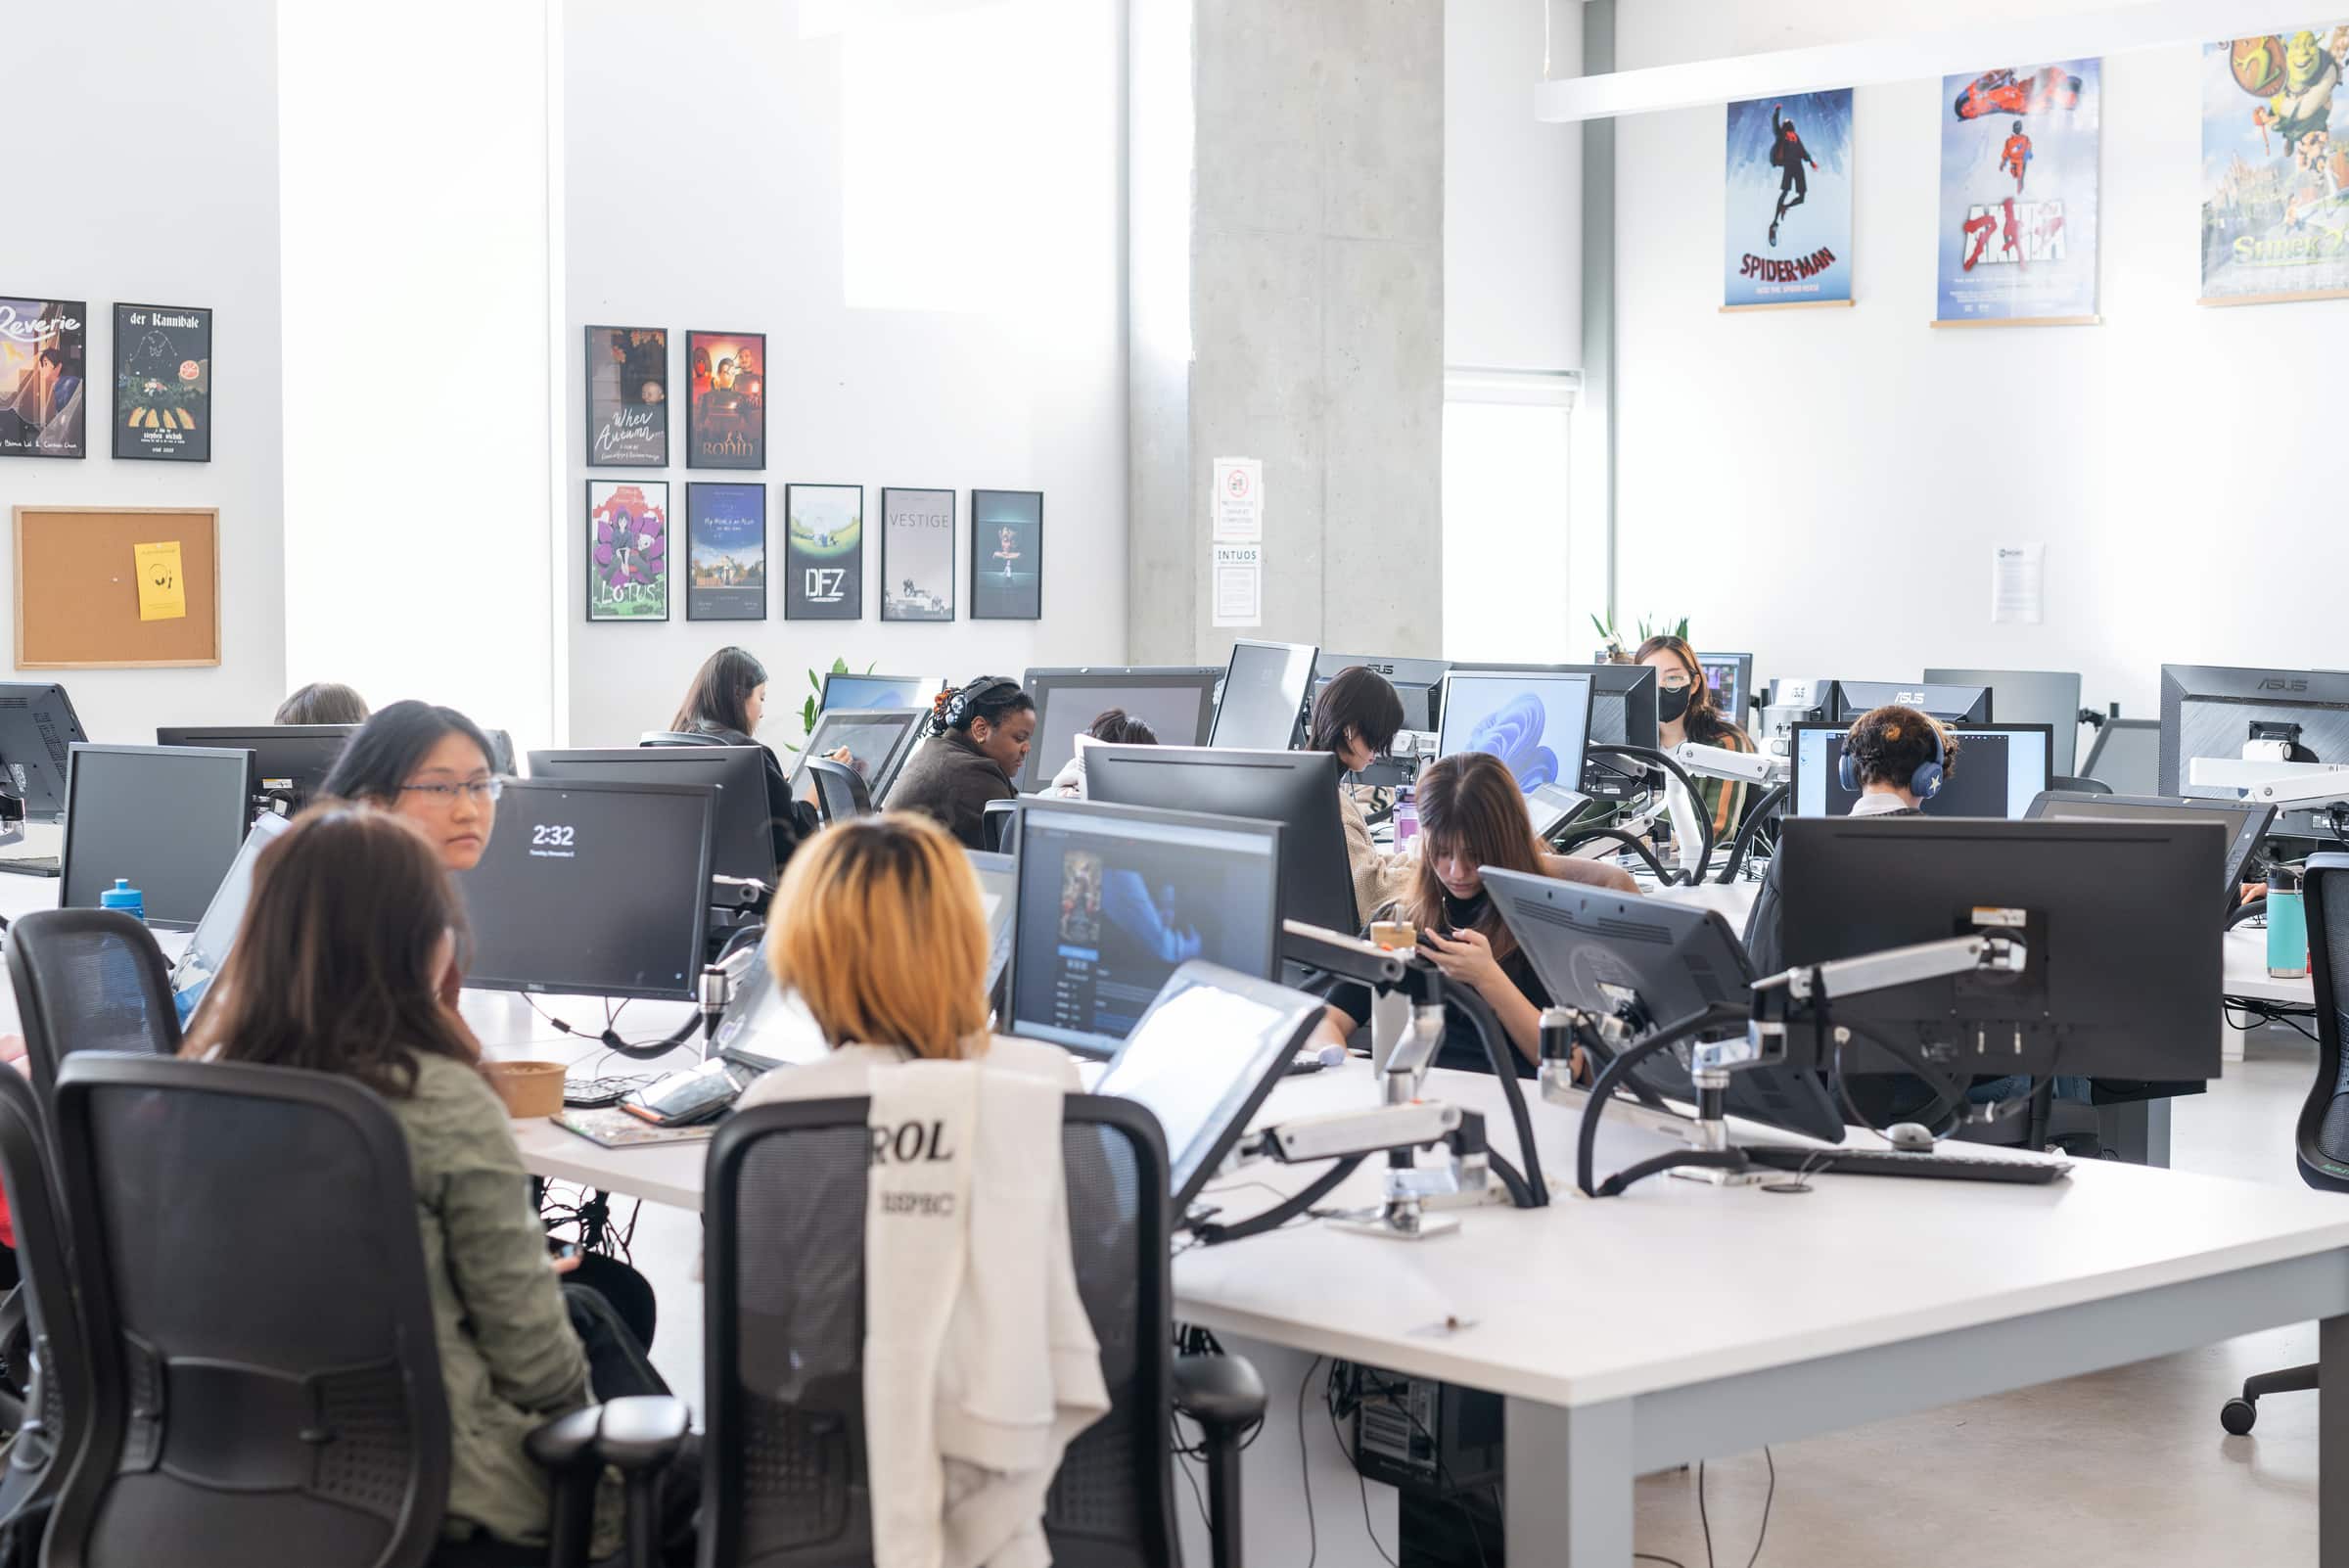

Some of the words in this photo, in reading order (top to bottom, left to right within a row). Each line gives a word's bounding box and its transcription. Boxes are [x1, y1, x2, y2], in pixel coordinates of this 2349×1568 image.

[1739, 246, 1836, 282] SPIDER-MAN
[130, 312, 147, 326] der
[152, 312, 200, 329] Kannibale
[611, 407, 654, 428] When
[889, 512, 949, 529] VESTIGE
[1218, 549, 1257, 560] INTUOS
[601, 579, 657, 604] LOTUS
[806, 568, 847, 597] DFZ
[2256, 678, 2309, 693] ASUS
[1894, 691, 1925, 705] ASUS
[531, 824, 575, 847] 2:32
